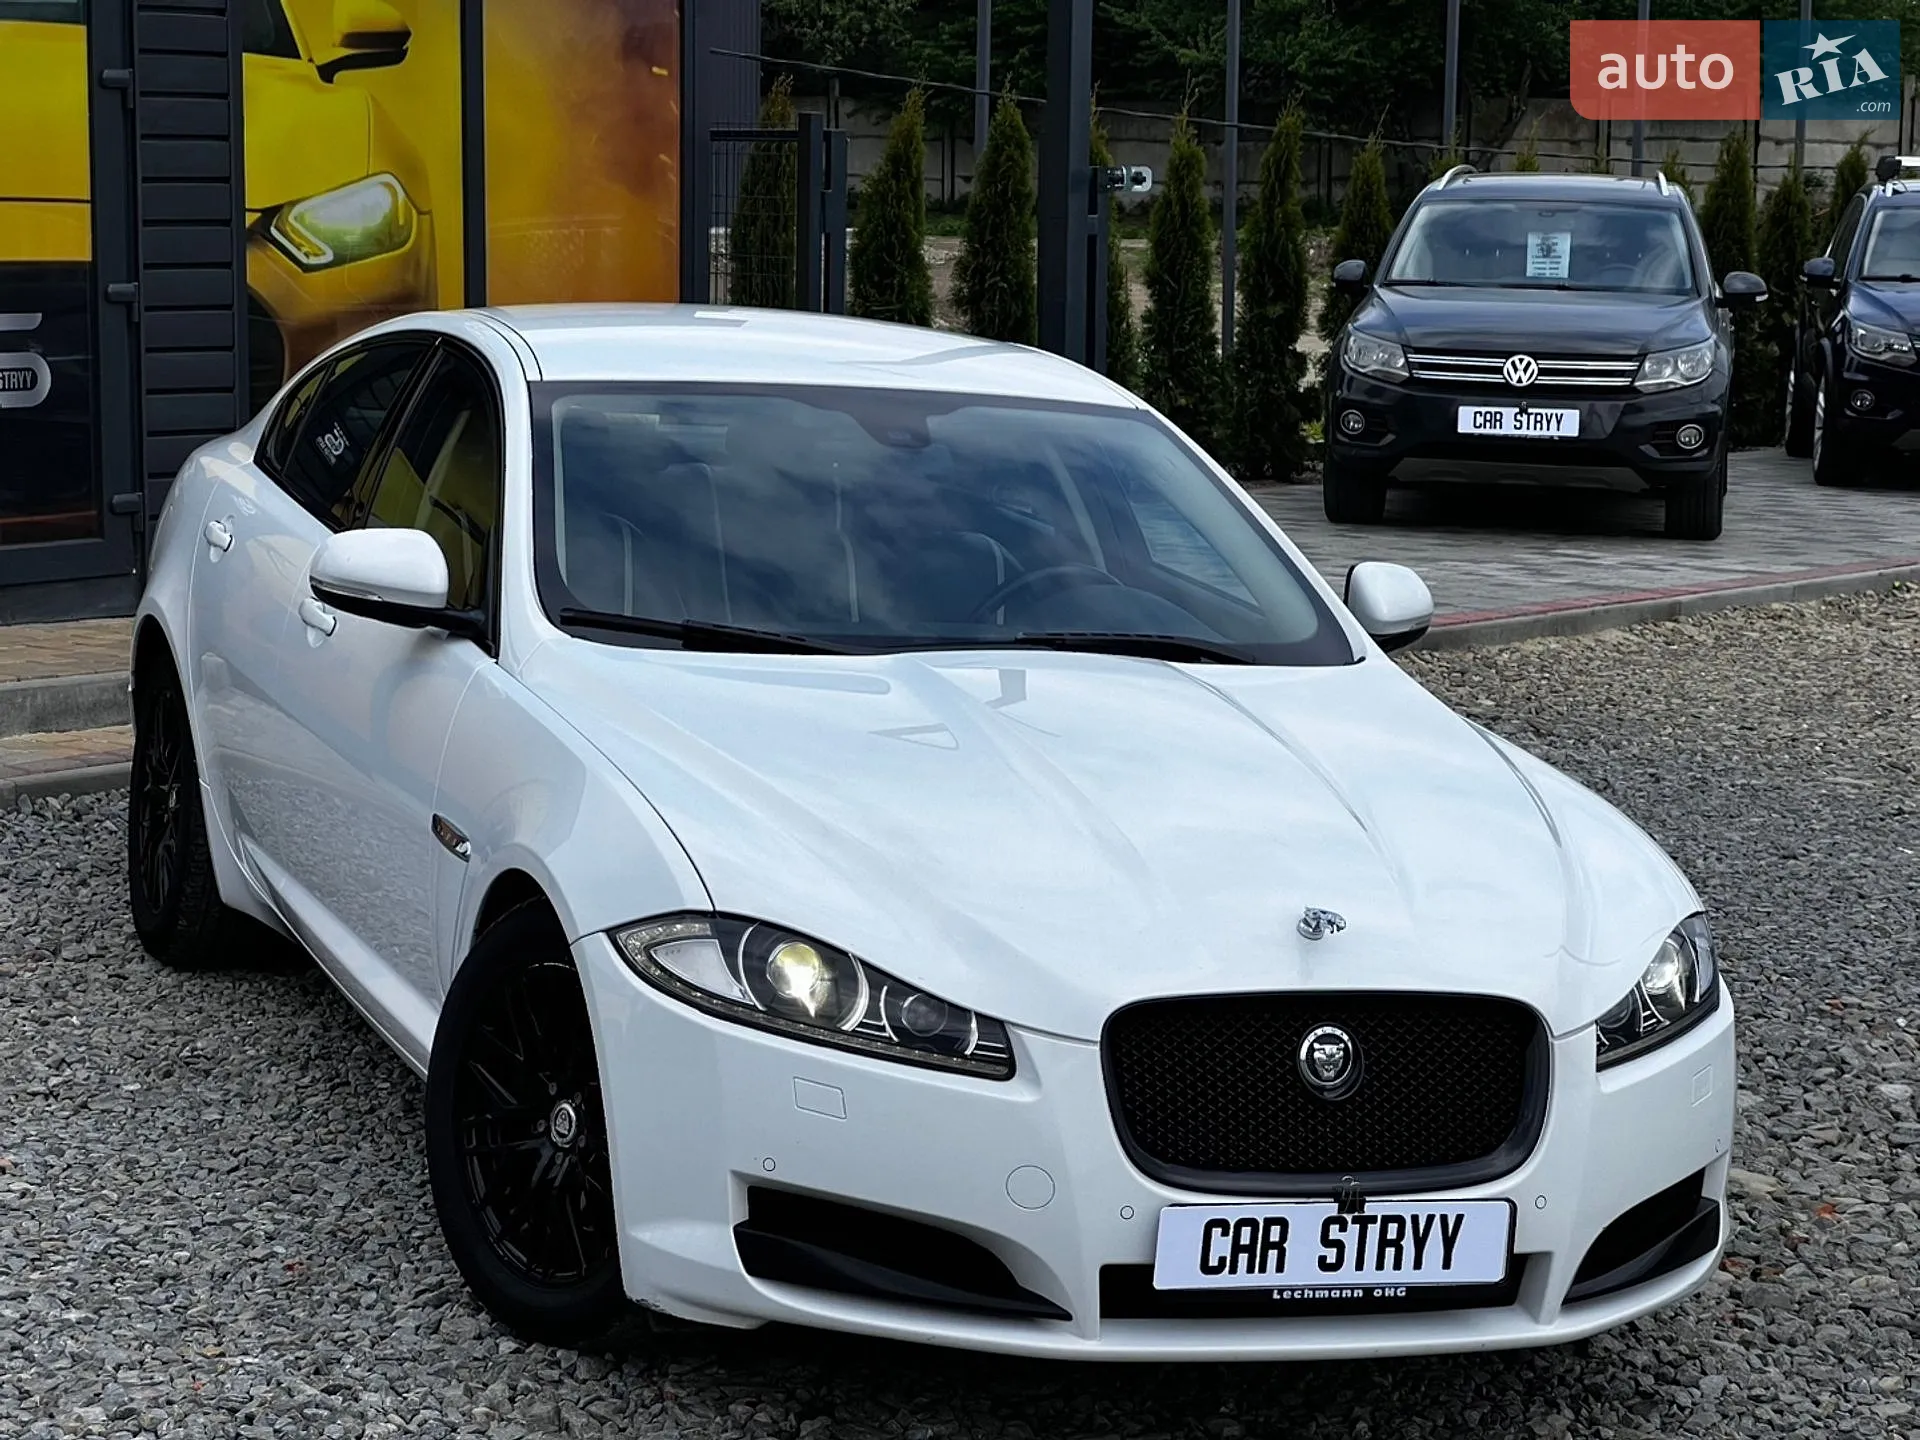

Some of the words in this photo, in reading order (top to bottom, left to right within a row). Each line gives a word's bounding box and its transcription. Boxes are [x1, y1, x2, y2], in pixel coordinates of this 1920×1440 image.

[1473, 410, 1503, 430] CAR
[1513, 411, 1563, 432] STRYY
[1200, 1215, 1289, 1276] CAR
[1317, 1212, 1465, 1273] STRYY
[1272, 1287, 1364, 1300] Lechmann
